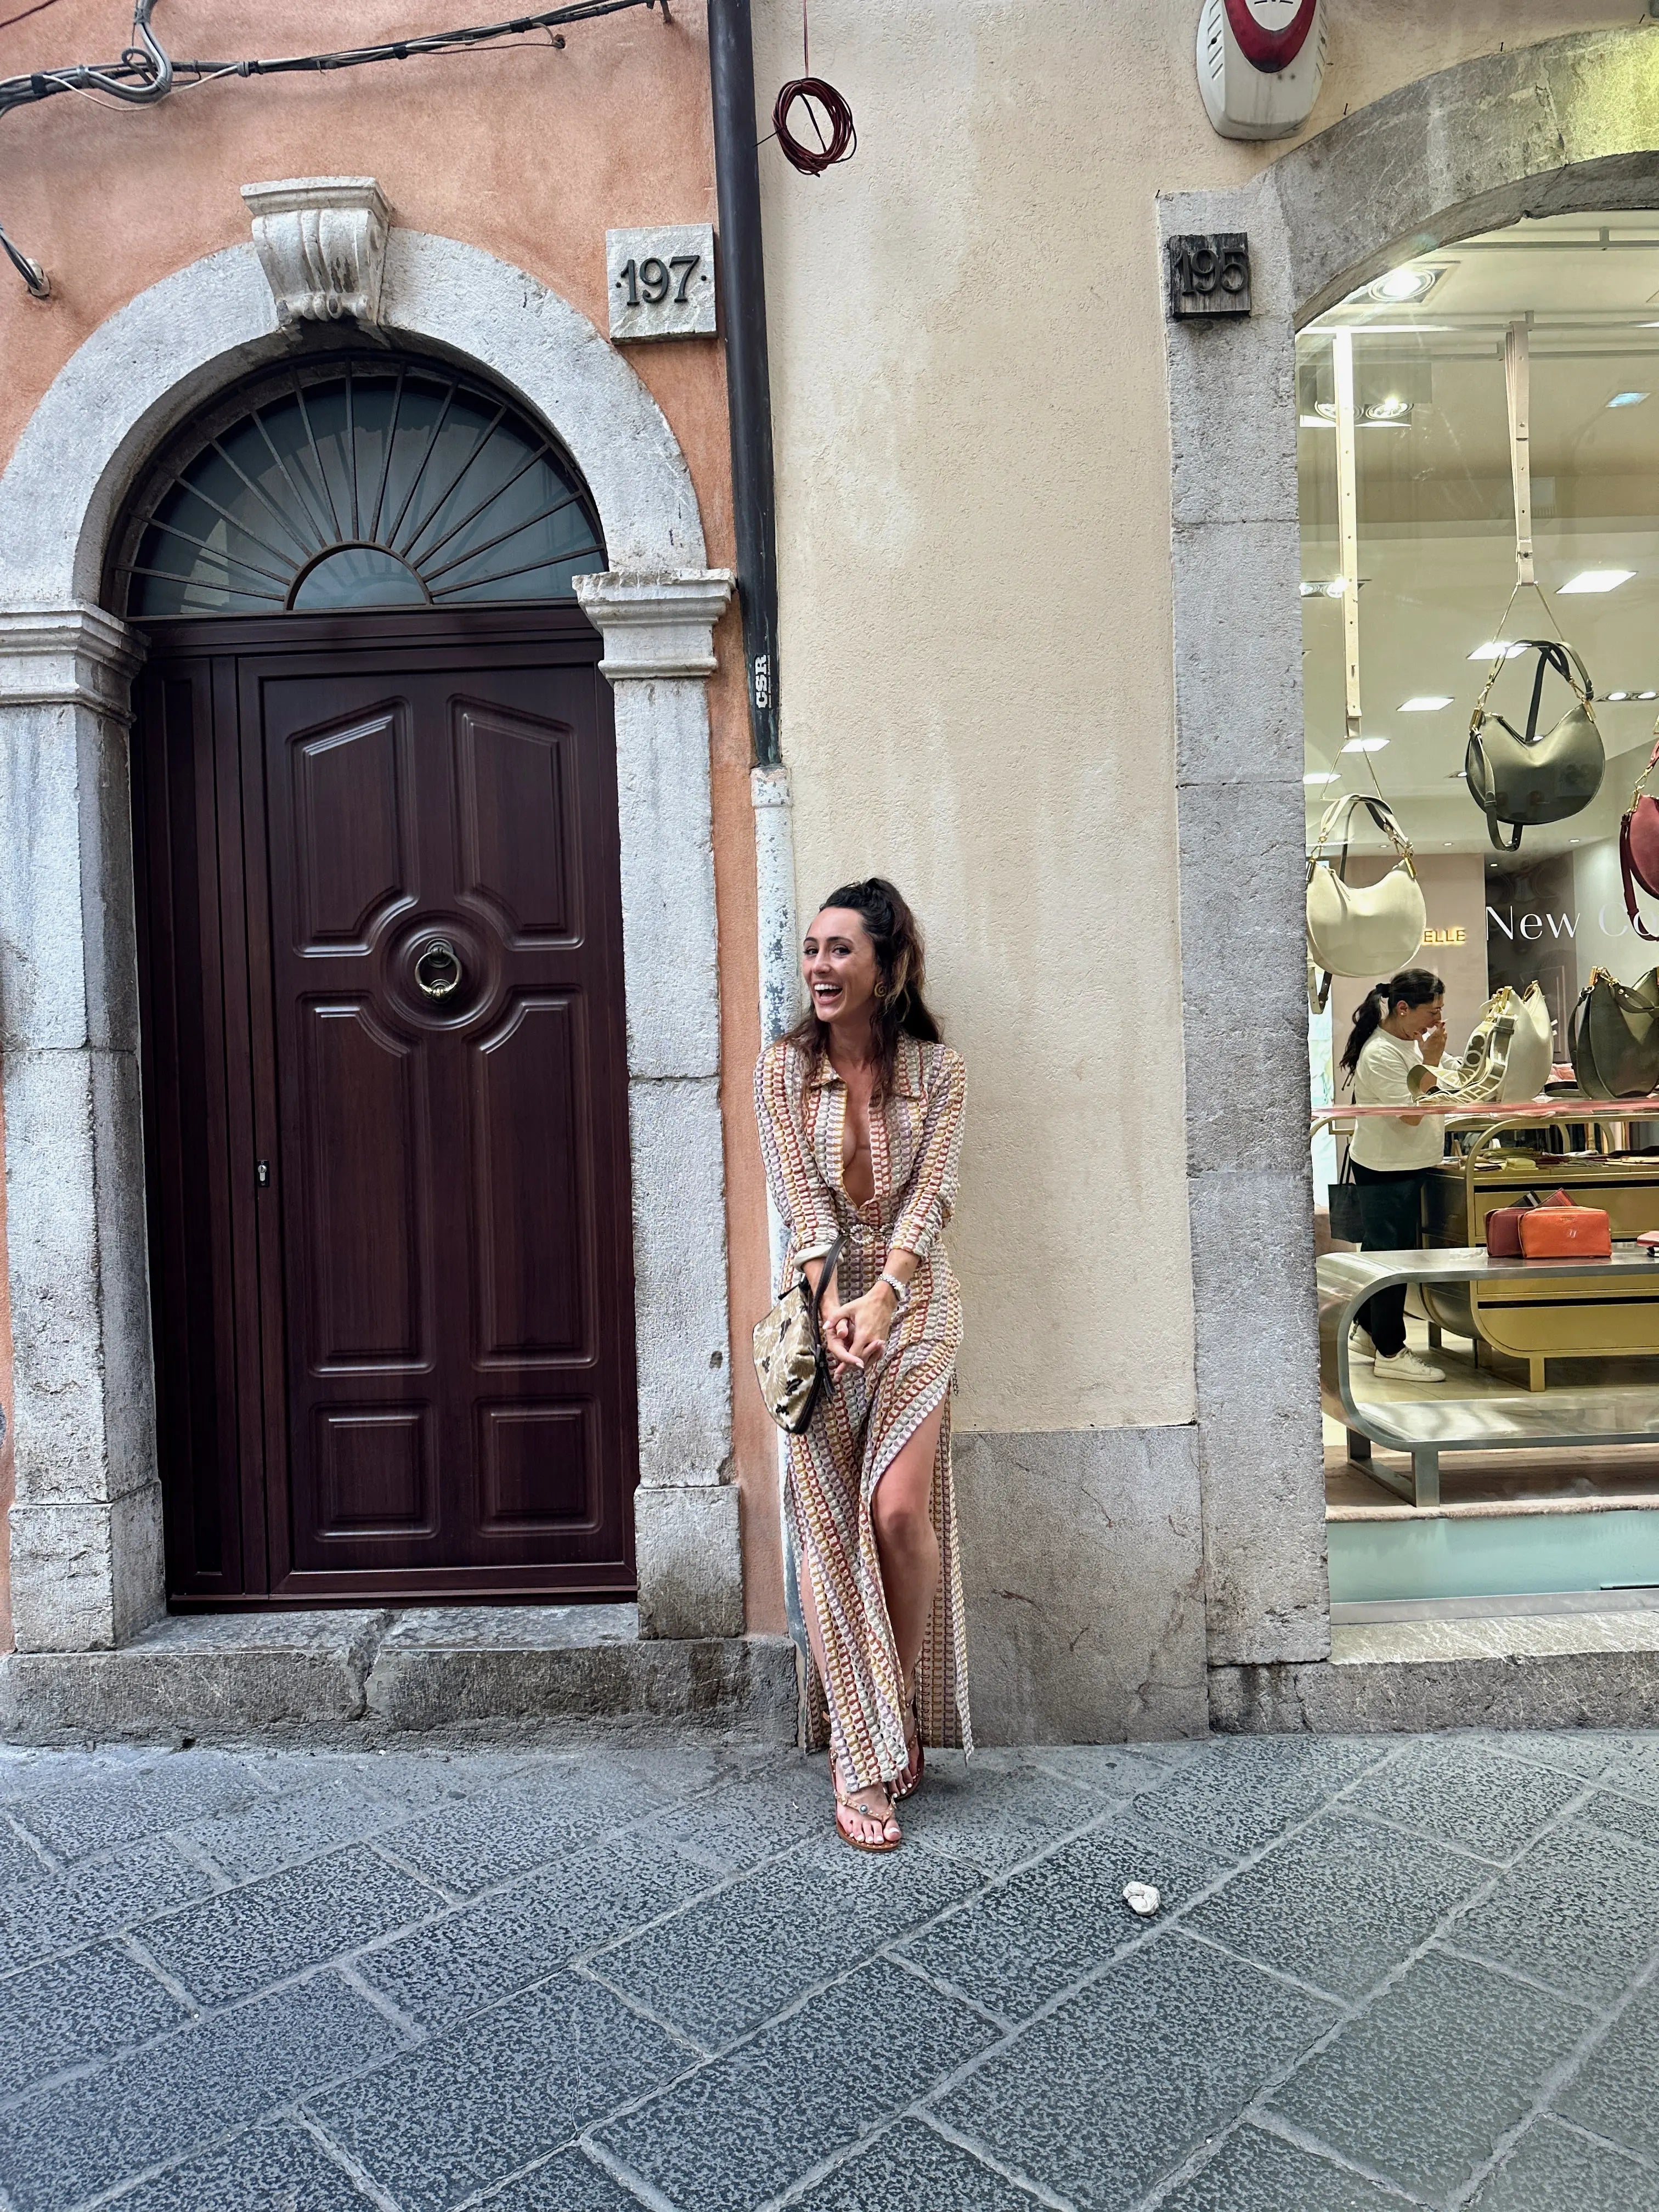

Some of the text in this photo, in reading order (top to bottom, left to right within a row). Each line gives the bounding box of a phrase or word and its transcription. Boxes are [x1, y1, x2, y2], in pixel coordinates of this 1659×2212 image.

[620, 255, 701, 306] 197
[1174, 247, 1249, 296] 195
[755, 654, 768, 708] CSR
[1424, 929, 1466, 943] ELLE
[1486, 905, 1581, 941] New
